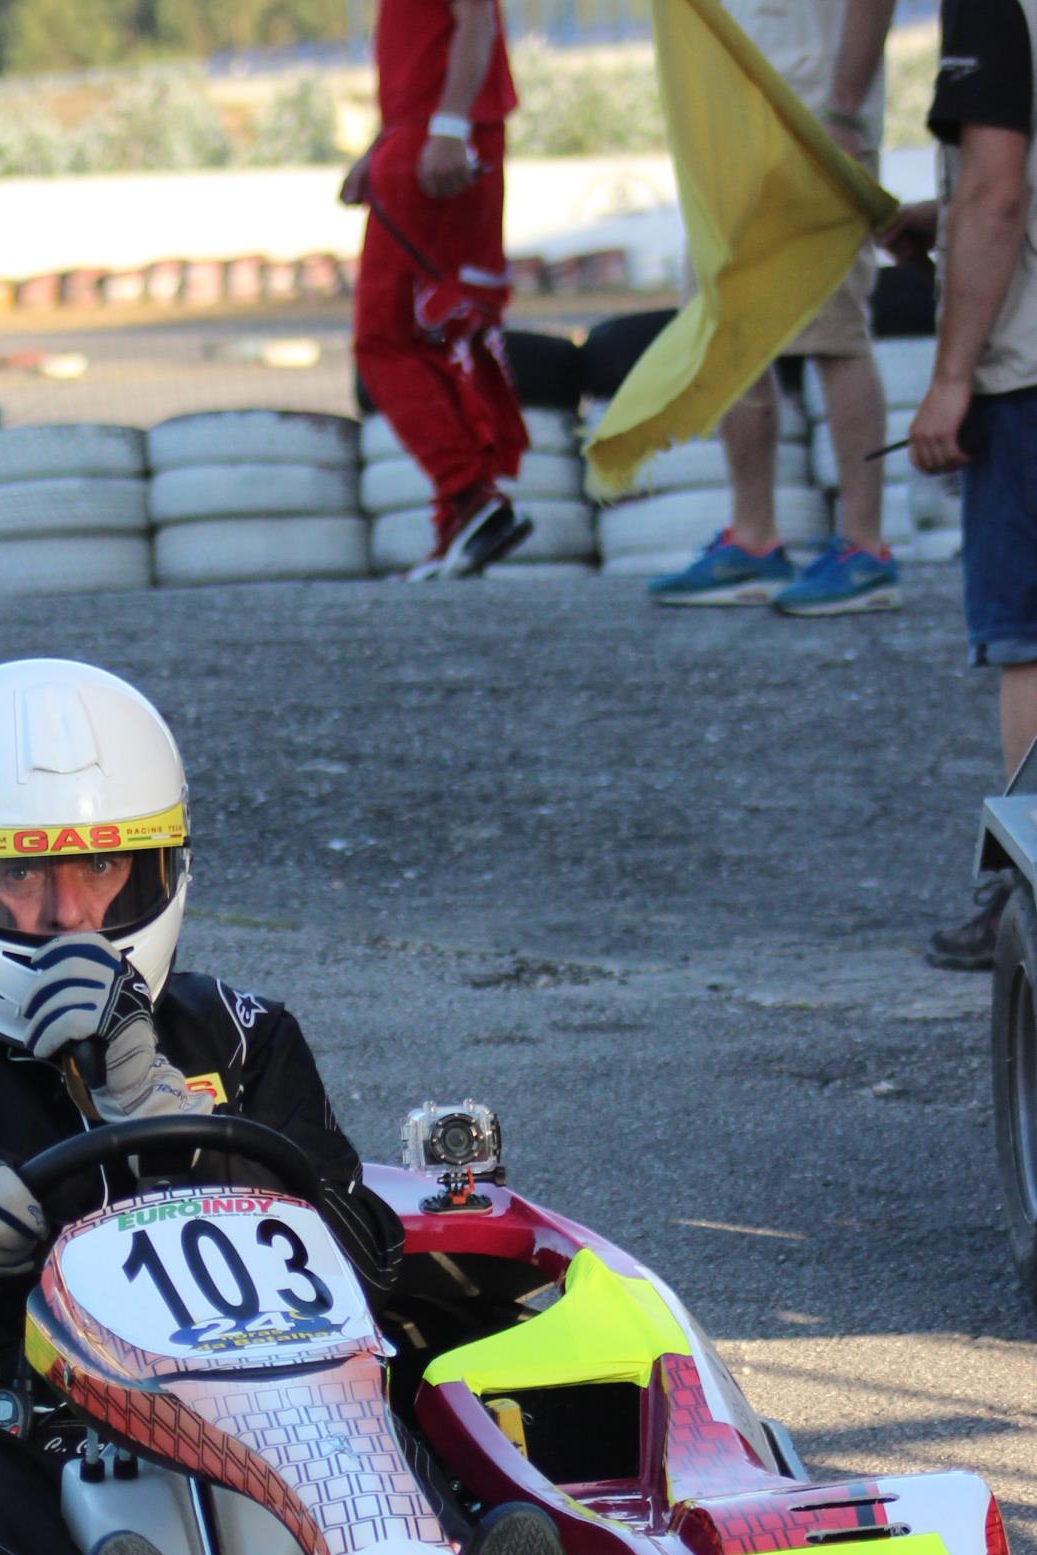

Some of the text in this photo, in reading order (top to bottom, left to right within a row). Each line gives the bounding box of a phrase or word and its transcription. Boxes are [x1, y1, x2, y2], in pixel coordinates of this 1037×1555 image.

[13, 825, 122, 854] GAS
[126, 825, 163, 836] RACING
[122, 1218, 334, 1329] 103
[190, 1310, 296, 1342] 24
